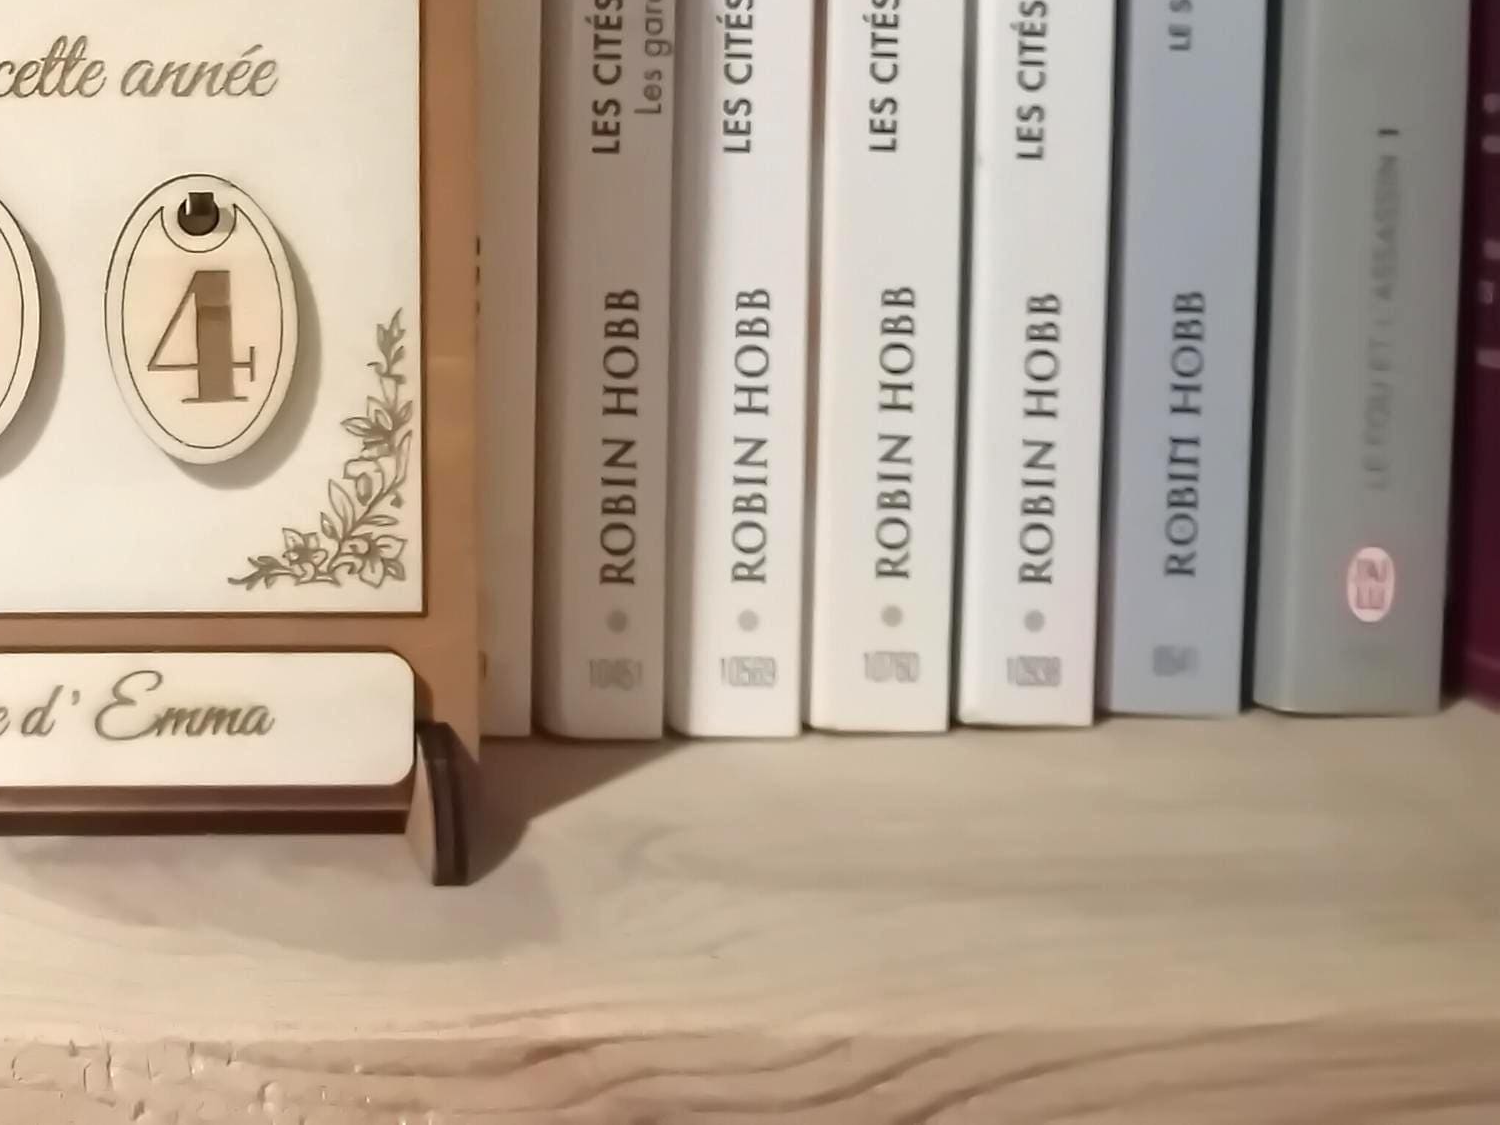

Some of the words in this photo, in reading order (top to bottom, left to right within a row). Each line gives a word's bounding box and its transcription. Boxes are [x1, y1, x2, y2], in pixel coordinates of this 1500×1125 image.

[121, 43, 278, 99] année
[634, 69, 664, 114] Les
[1010, 0, 1047, 91] CITÉS
[1168, 23, 1192, 50] LE
[591, 98, 621, 154] LES
[723, 97, 753, 153] LES
[869, 96, 898, 152] LES
[1016, 104, 1045, 160] LES
[147, 270, 255, 404] 4
[602, 287, 640, 416] HOBB
[734, 286, 772, 415] HOBB
[878, 284, 916, 413] HOBB
[1023, 291, 1062, 419] HOBB
[1170, 289, 1207, 415] HOBB
[599, 436, 638, 585] ROBIN
[730, 434, 770, 583] ROBIN
[875, 431, 913, 578] ROBIN
[1018, 437, 1057, 585] ROBIN
[1163, 434, 1202, 576] ROBIN
[93, 669, 275, 742] Emma
